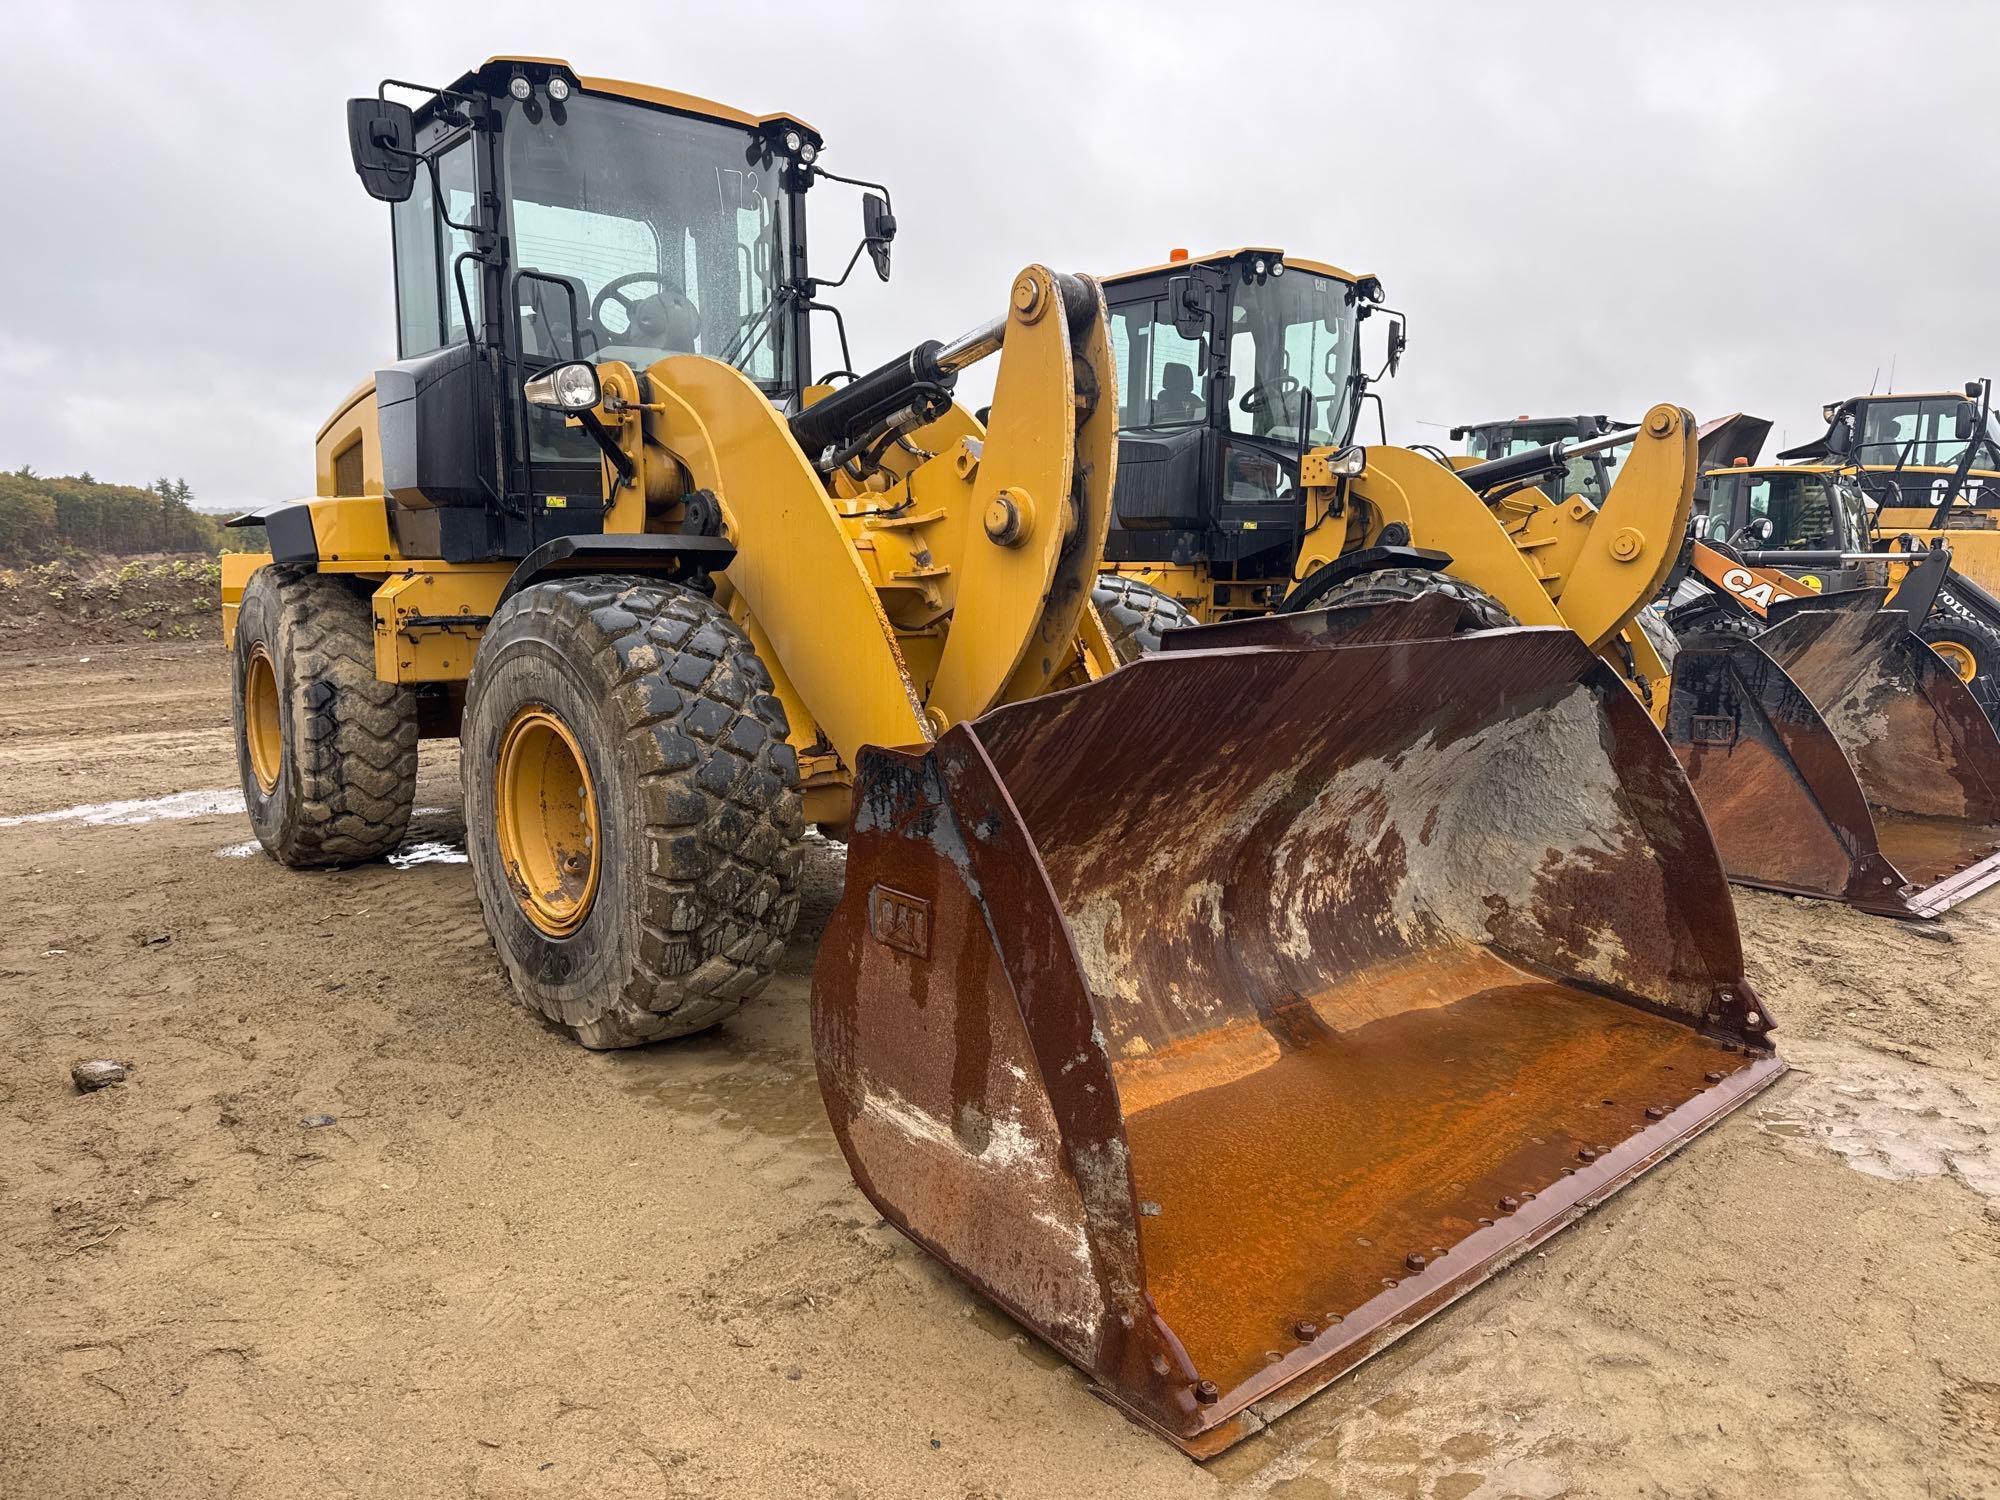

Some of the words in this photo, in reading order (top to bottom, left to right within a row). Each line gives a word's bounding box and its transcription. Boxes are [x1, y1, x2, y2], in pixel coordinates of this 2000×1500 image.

[714, 166, 763, 215] 173
[1314, 278, 1327, 292] CAT
[1937, 588, 1980, 620] VOLV
